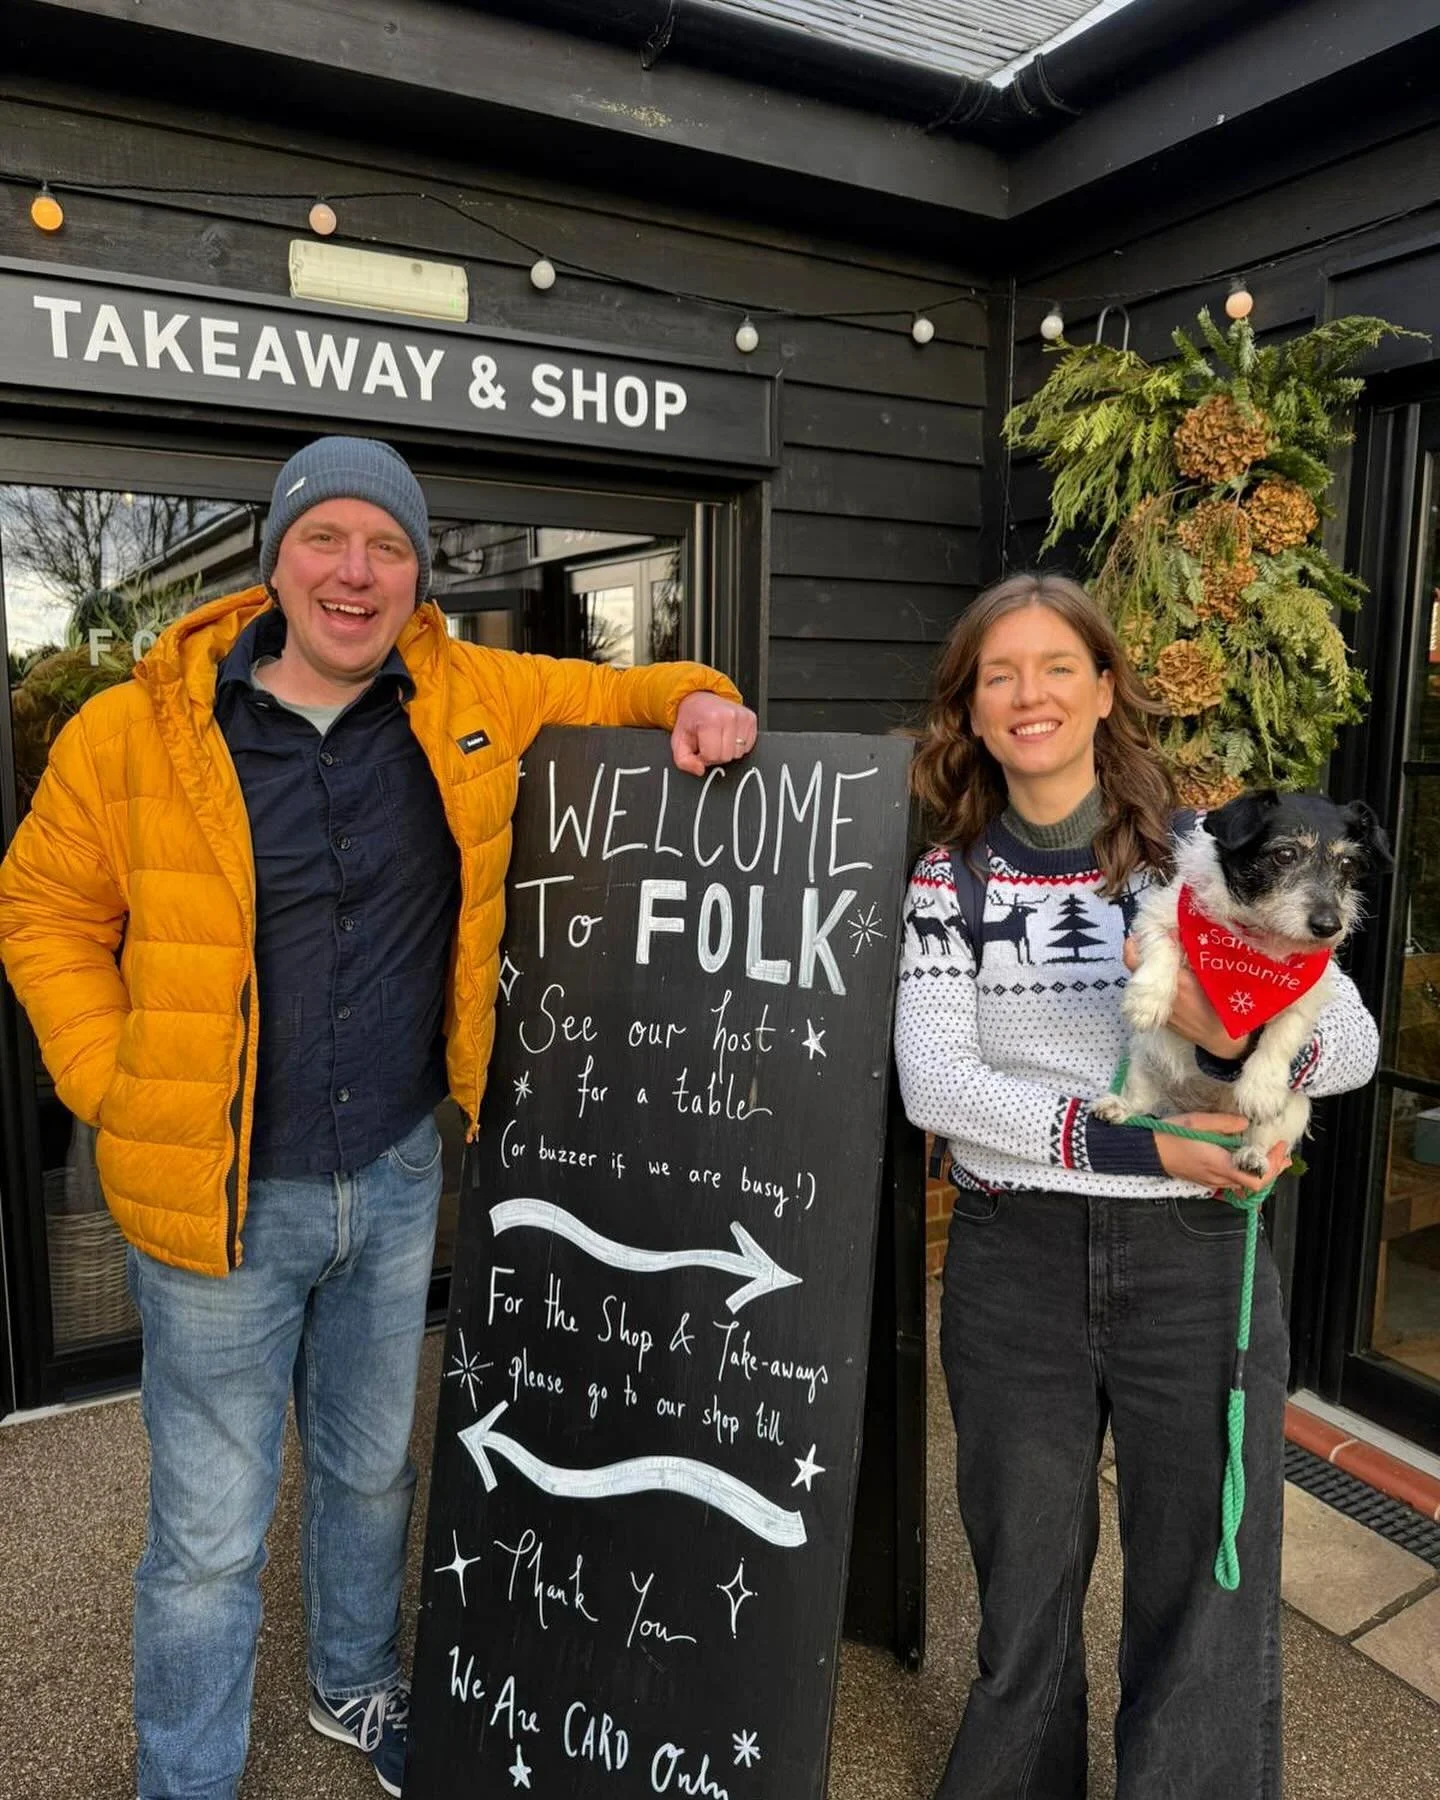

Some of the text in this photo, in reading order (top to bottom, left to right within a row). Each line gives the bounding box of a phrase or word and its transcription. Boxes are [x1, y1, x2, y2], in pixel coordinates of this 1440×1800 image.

[33, 295, 687, 431] TAKEAWAY & SHOP
[549, 760, 878, 882] WELCOME
[515, 876, 857, 996] To FOLK
[1200, 951, 1300, 990] Favourite
[520, 984, 776, 1083] See our host
[577, 1055, 772, 1120] for a table
[501, 1120, 527, 1168] (or
[540, 1135, 597, 1168] buzzer
[612, 1152, 626, 1179] if
[649, 1161, 670, 1177] we
[690, 1170, 721, 1188] are
[488, 1266, 828, 1403] For the Shop & Take-aways
[588, 1386, 607, 1418] go
[624, 1376, 637, 1406] to
[657, 1400, 685, 1418] our
[703, 1395, 739, 1444] shop
[756, 1402, 784, 1446] till
[493, 1529, 696, 1647] Thank You
[448, 1645, 485, 1701] We
[490, 1676, 540, 1739] Are
[564, 1701, 629, 1771] CARD
